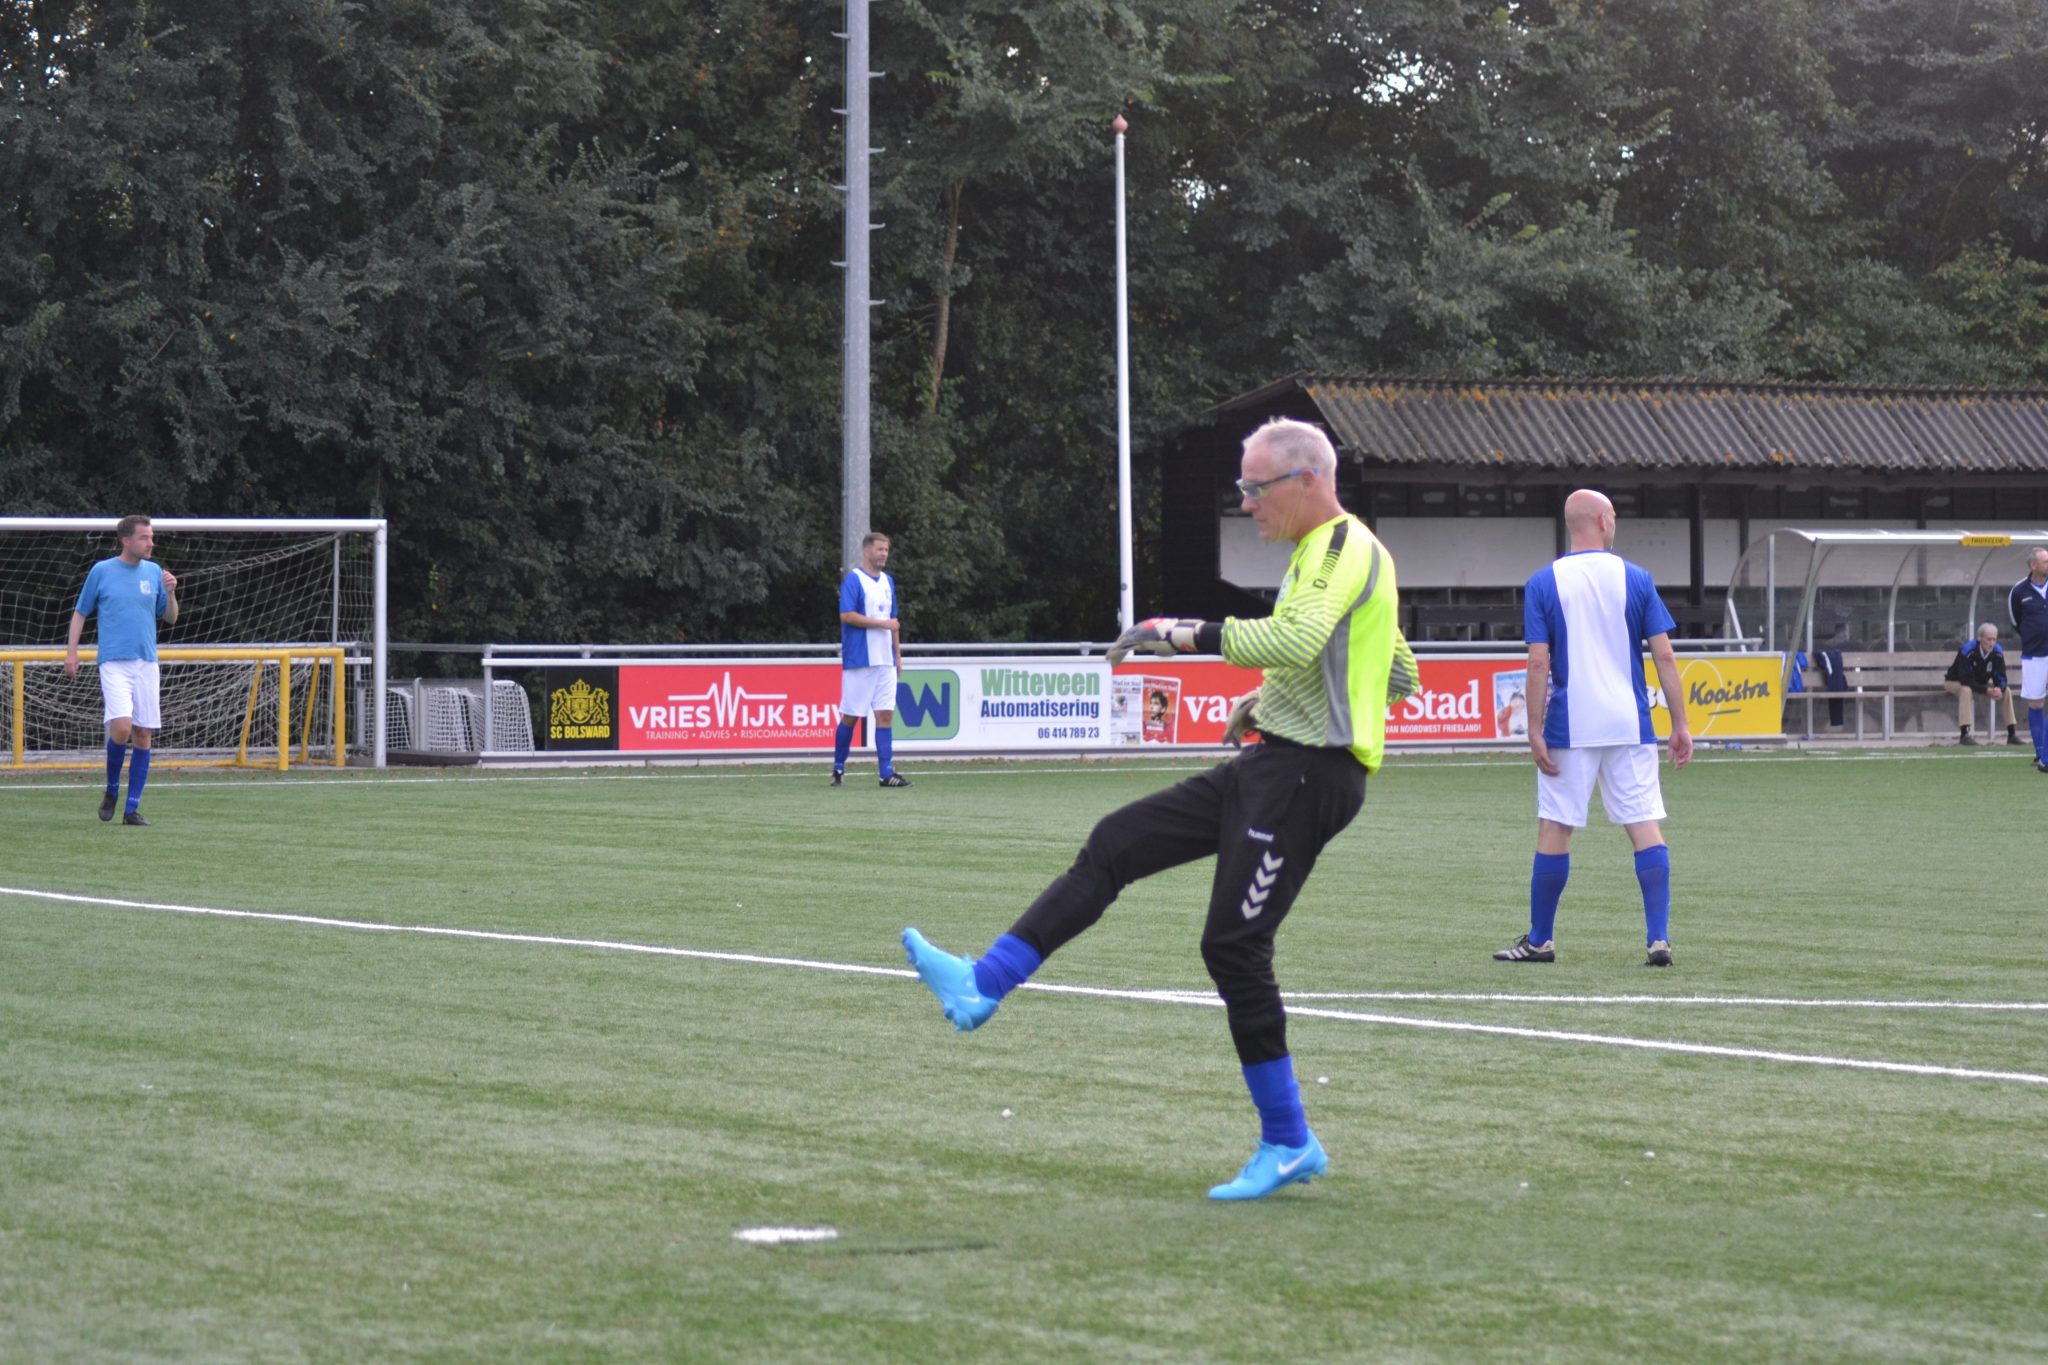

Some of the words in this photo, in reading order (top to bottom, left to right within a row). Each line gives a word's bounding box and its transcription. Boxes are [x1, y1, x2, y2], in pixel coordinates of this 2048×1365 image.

[980, 668, 1100, 697] Witteveen
[1402, 679, 1482, 720] Stad
[1689, 678, 1770, 706] Kooistra
[980, 699, 1100, 719] Automatisering
[550, 725, 563, 739] SC
[564, 725, 610, 738] BOLSWARD
[646, 730, 689, 740] TRAINING
[699, 729, 730, 739] ADVIES
[741, 728, 834, 738] RISICOMANAGEMENT
[1038, 728, 1050, 739] 06
[1052, 728, 1068, 739] 414
[1070, 727, 1086, 738] 789
[1088, 727, 1100, 738] 23
[1400, 724, 1441, 733] NOORDWEST
[1442, 723, 1482, 732] FRIESLAND!
